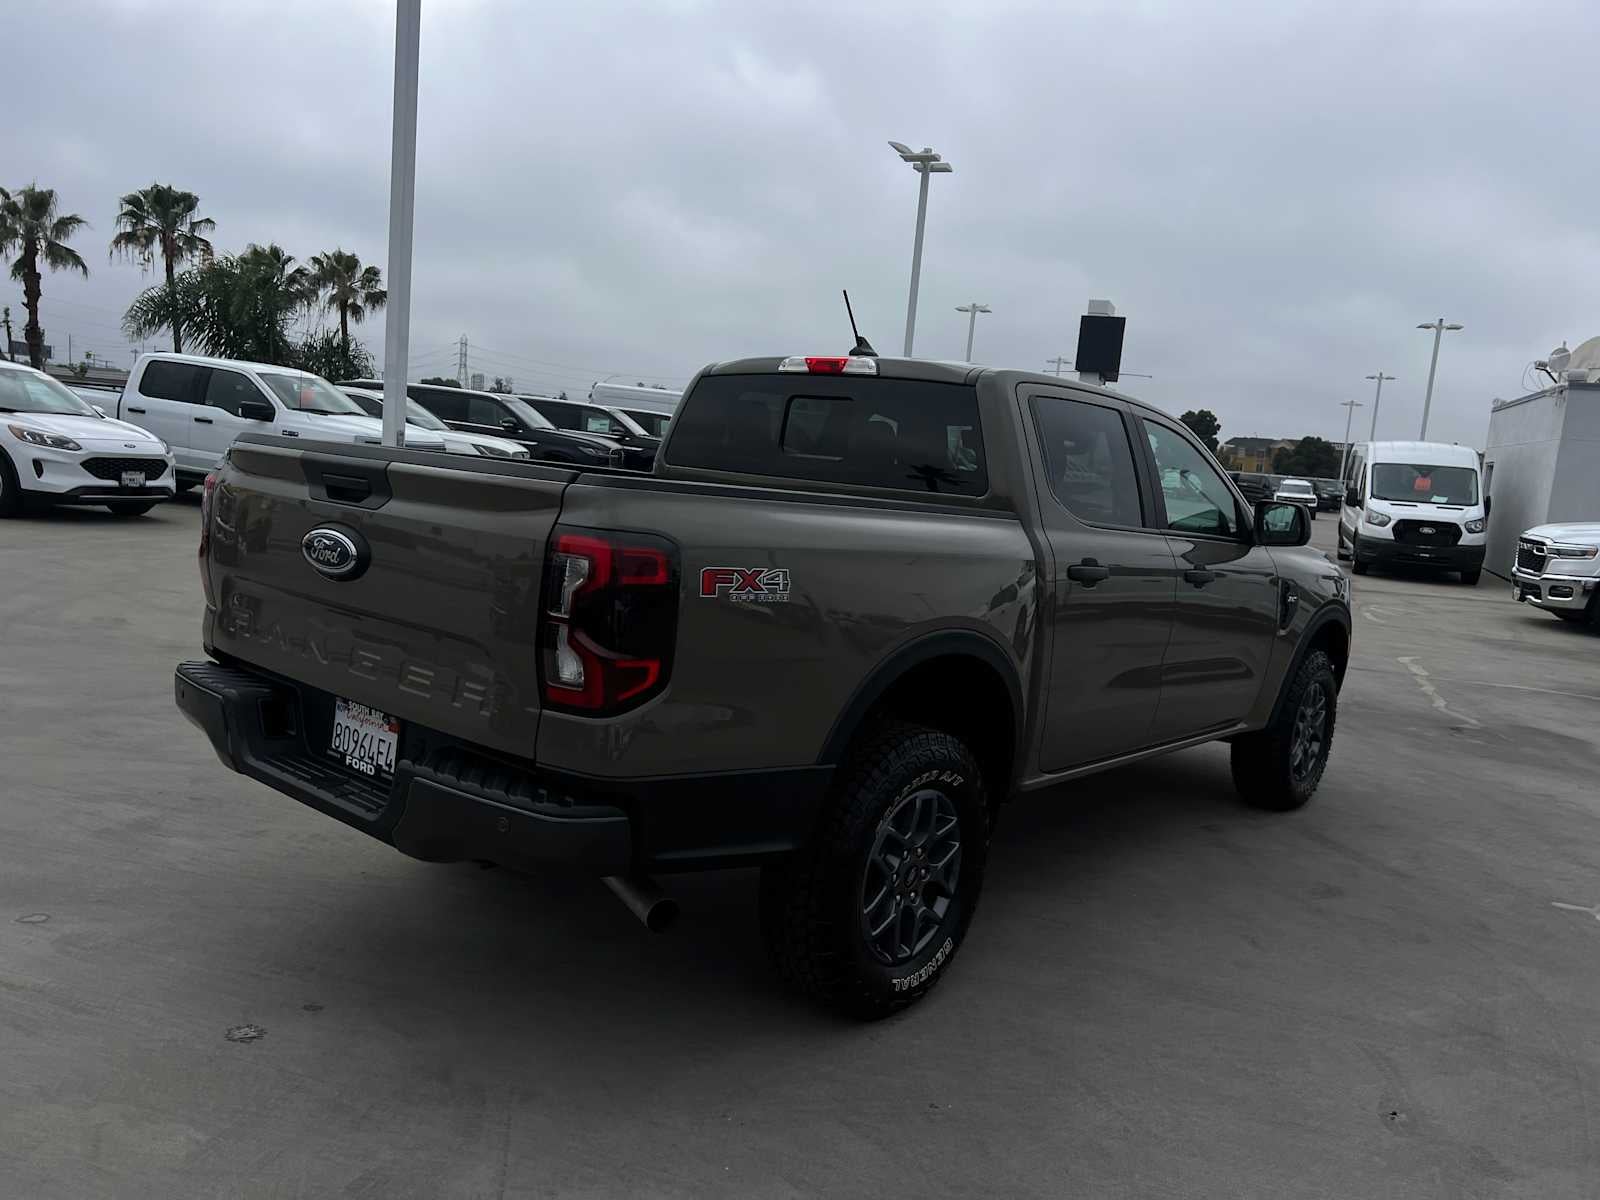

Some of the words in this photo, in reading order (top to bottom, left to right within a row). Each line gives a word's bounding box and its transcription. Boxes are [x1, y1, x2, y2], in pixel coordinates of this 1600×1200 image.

[310, 536, 341, 564] Ford
[699, 566, 791, 598] FX4
[229, 606, 496, 718] RANGER
[345, 755, 375, 776] FORD
[891, 936, 953, 992] GENERAL
